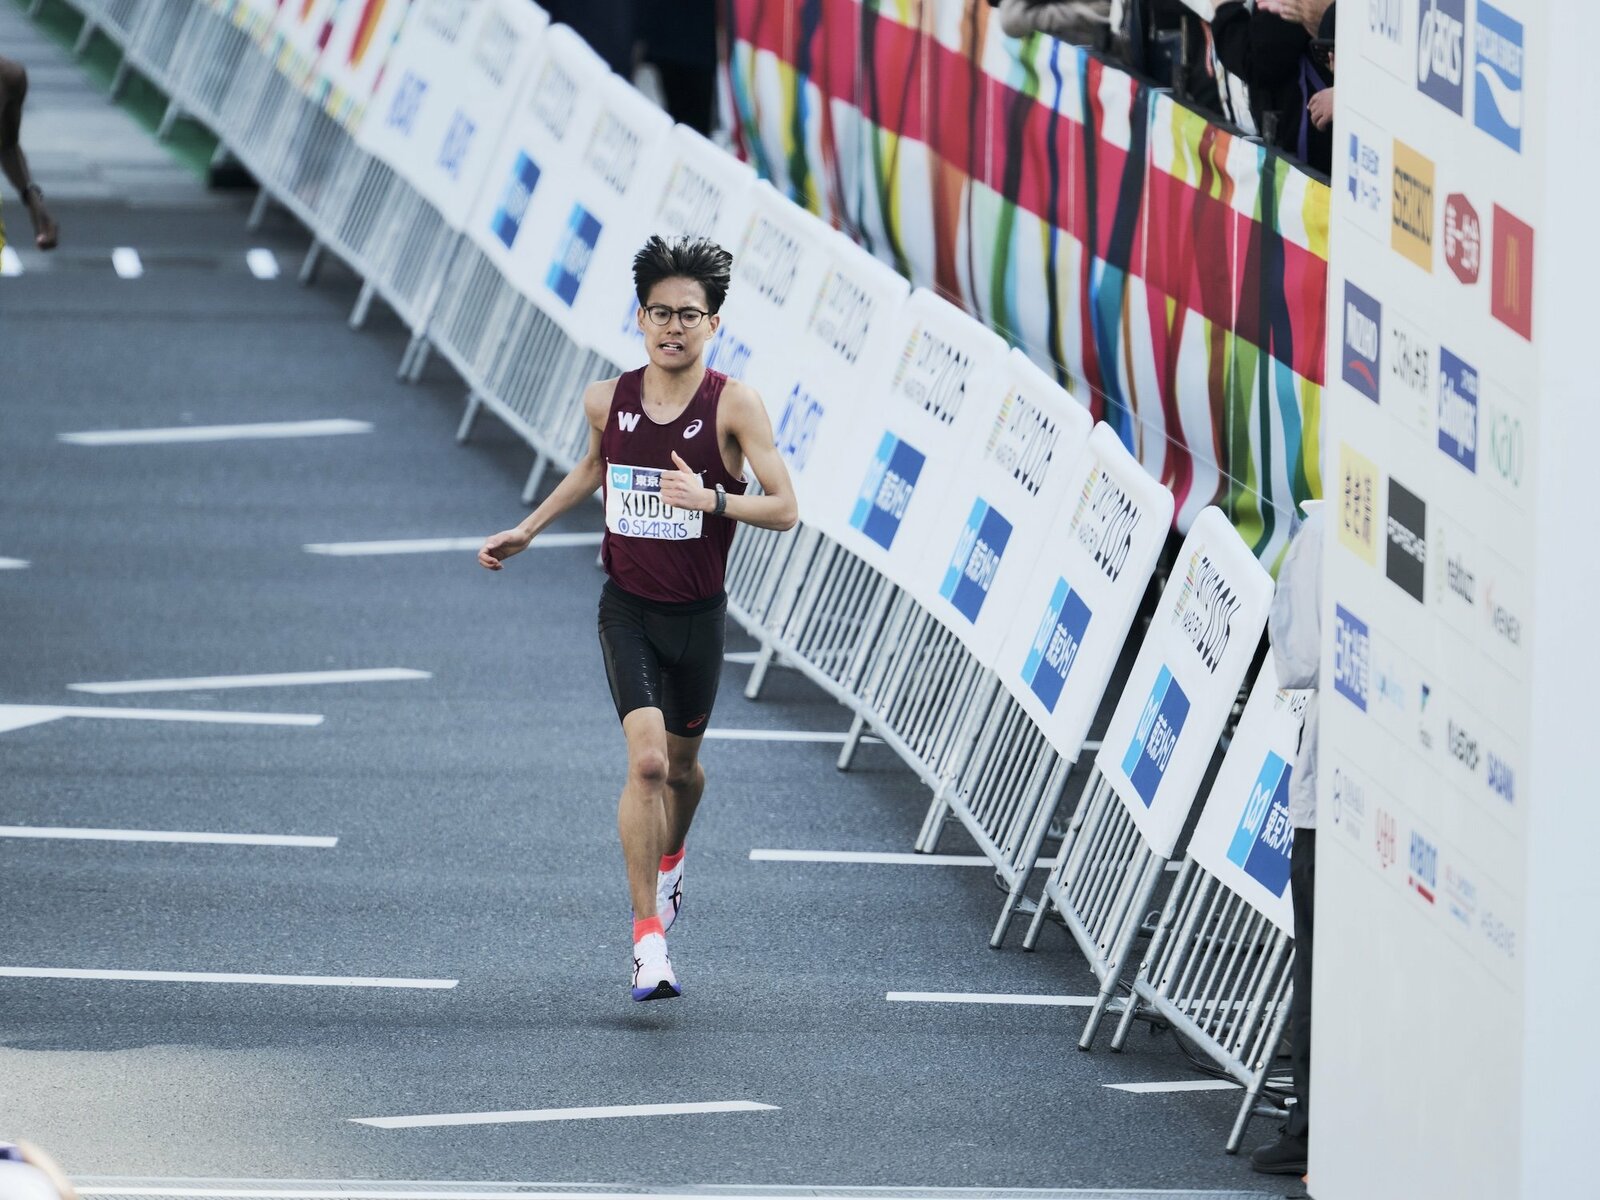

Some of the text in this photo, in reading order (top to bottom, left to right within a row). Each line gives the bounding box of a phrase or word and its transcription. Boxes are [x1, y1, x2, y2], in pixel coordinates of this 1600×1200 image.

[1392, 165, 1432, 246] SEIKO
[617, 411, 641, 432] W
[621, 492, 673, 519] KUDO
[632, 520, 688, 539] STARTS
